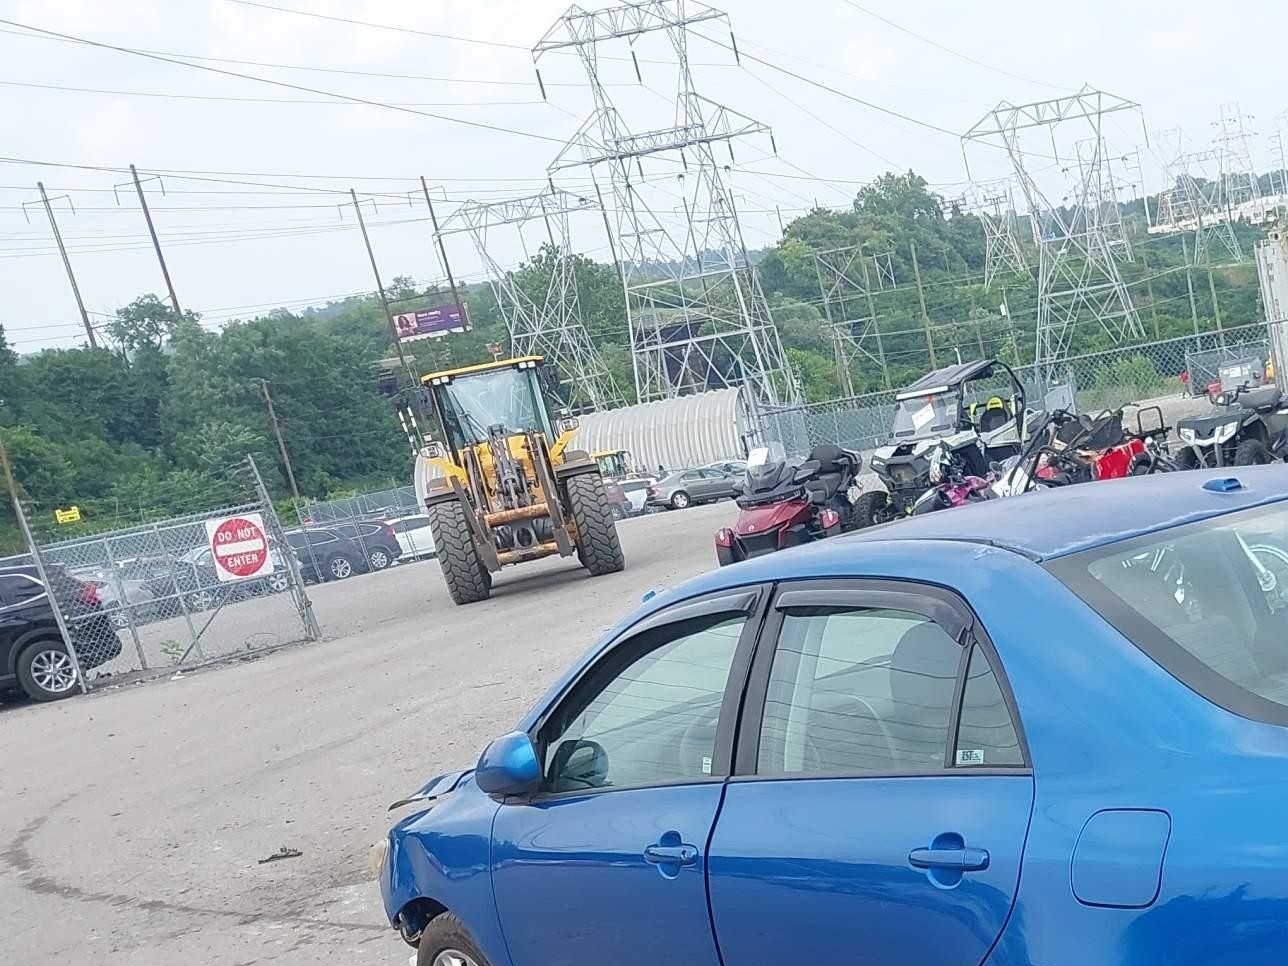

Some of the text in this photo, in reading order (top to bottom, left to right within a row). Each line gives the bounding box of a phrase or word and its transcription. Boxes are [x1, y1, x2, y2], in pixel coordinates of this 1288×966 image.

[217, 527, 256, 542] DO NOT
[227, 553, 259, 568] ENTER
